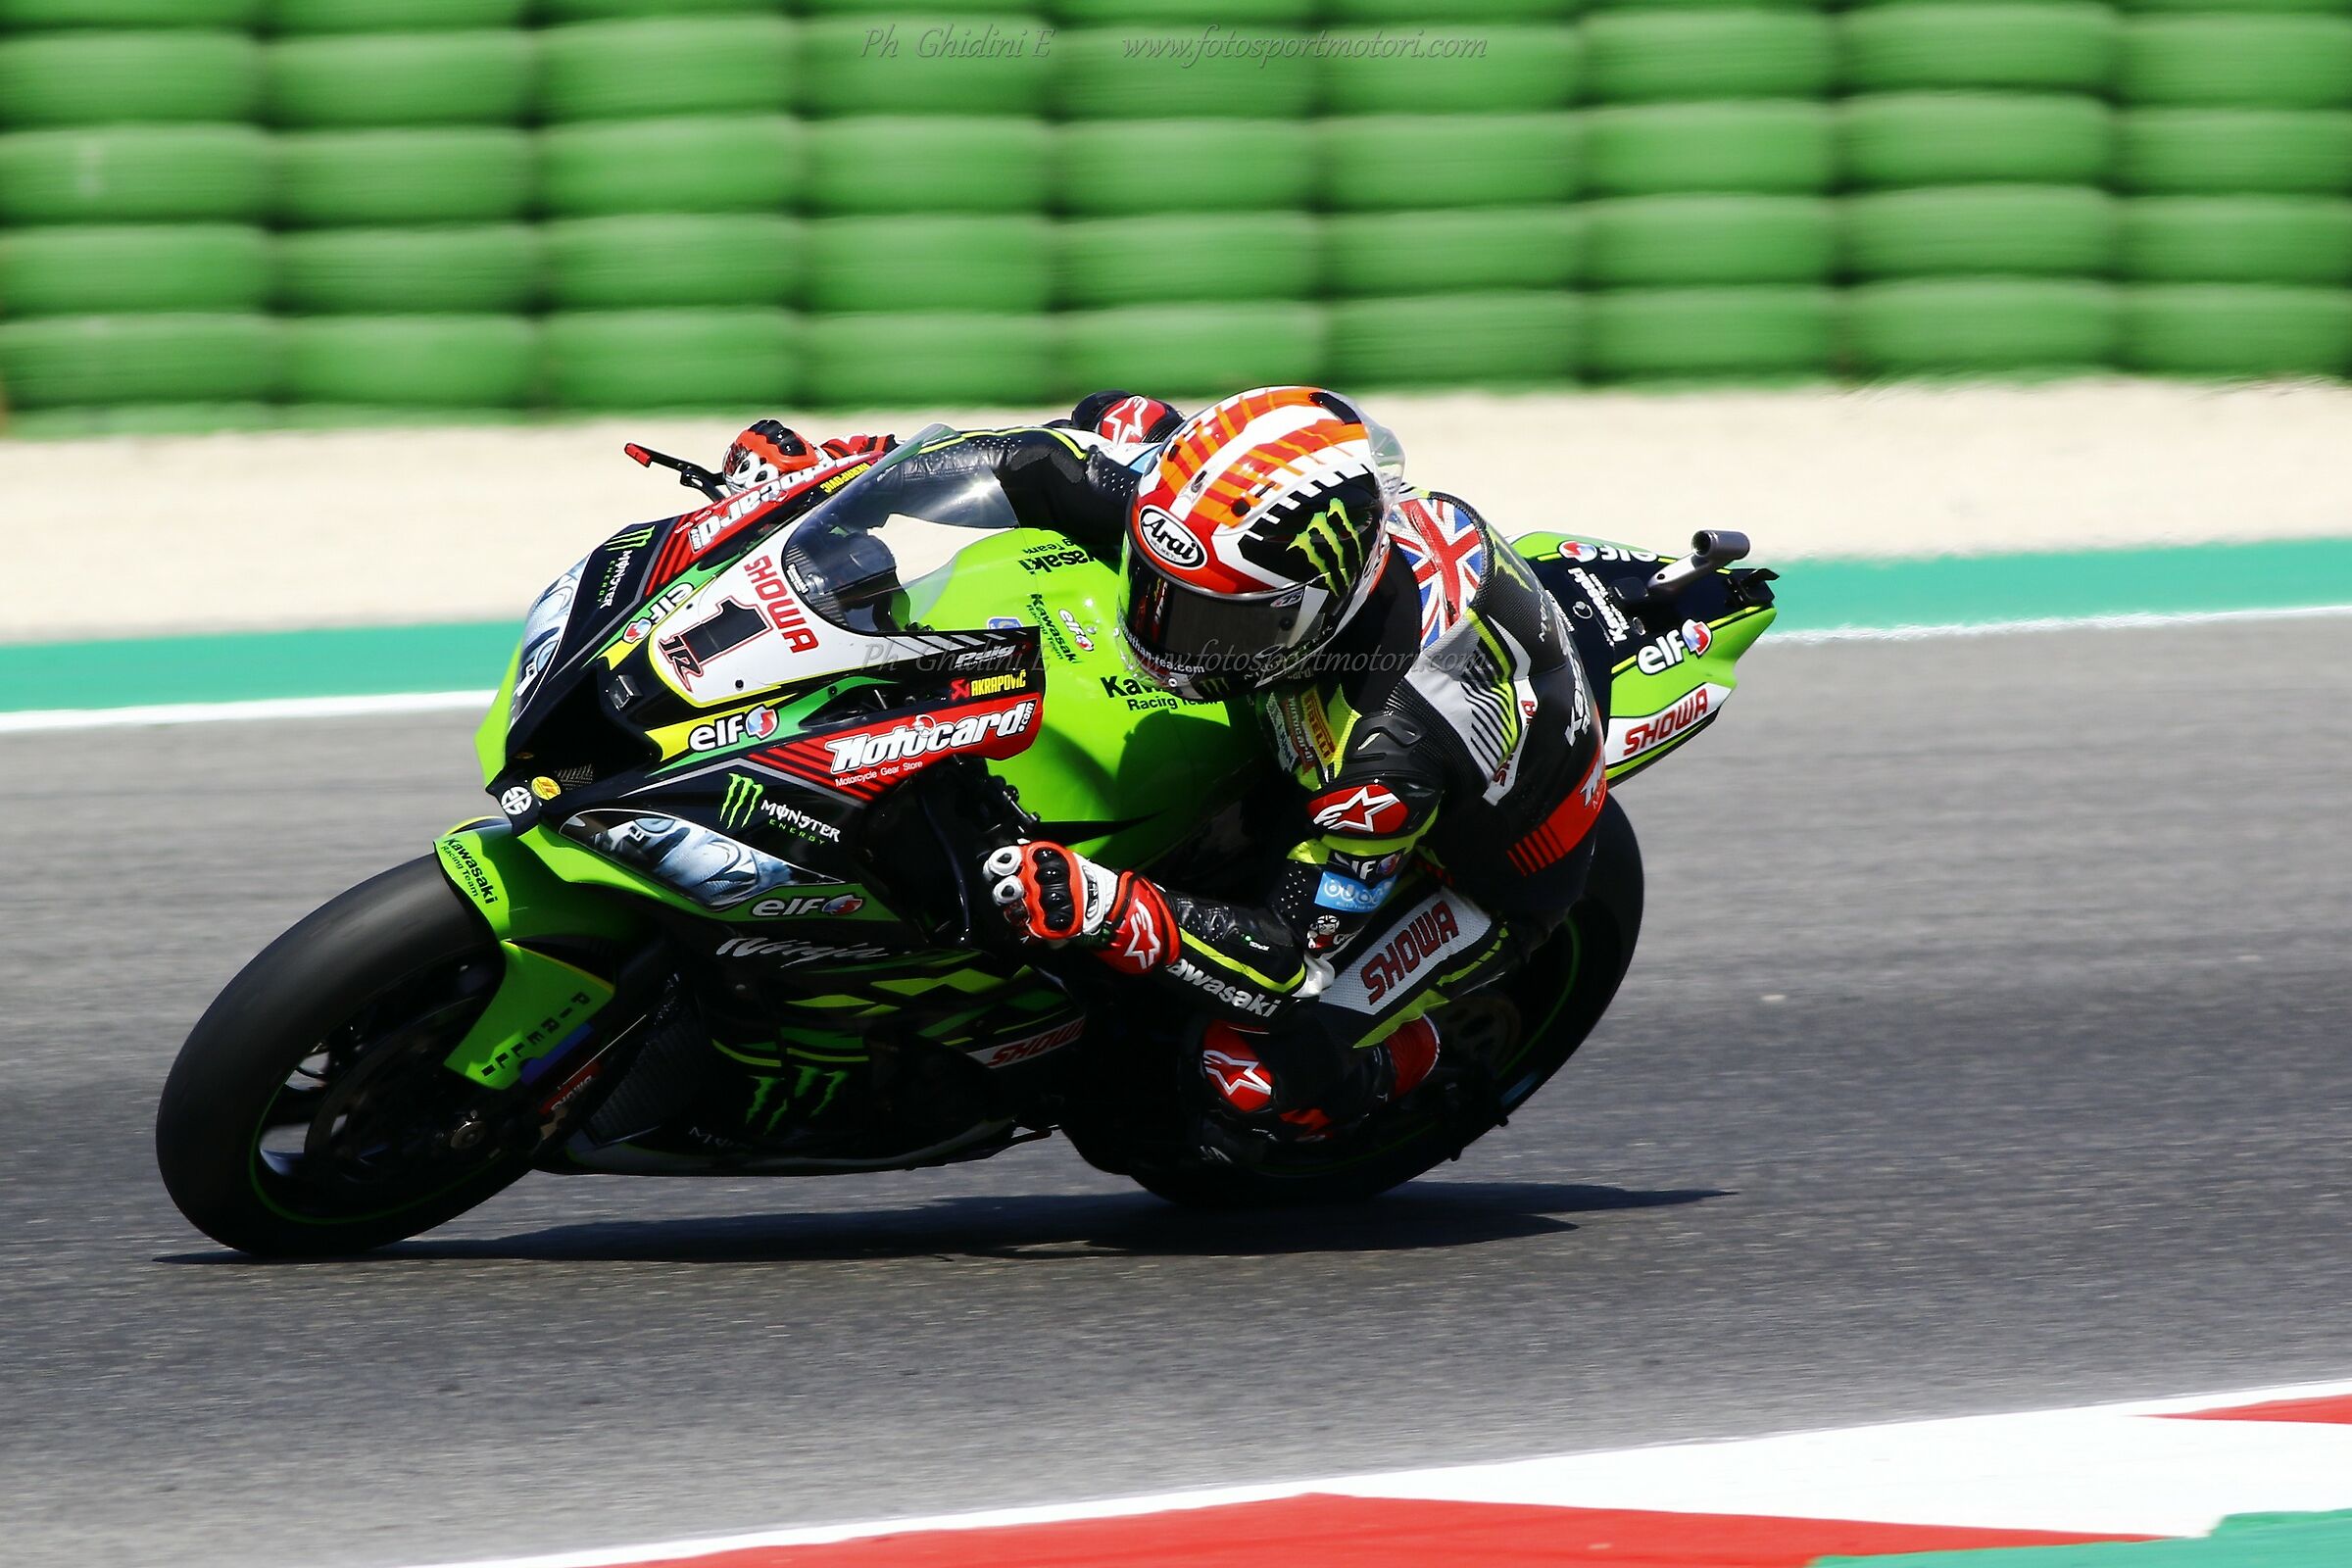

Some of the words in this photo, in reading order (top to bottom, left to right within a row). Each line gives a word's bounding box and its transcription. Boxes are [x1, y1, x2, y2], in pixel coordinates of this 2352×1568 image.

[1142, 517, 1198, 560] Arai
[648, 582, 695, 624] elf
[744, 555, 819, 654] SHOWA
[1058, 609, 1085, 637] elf
[677, 596, 773, 666] 1
[1638, 629, 1685, 675] elf
[689, 716, 745, 753] elf
[825, 699, 1037, 774] Motocard.com
[1623, 688, 1708, 757] SHOWA
[835, 768, 878, 788] Motorcycle
[880, 764, 902, 776] Gear
[903, 760, 923, 771] Store
[760, 799, 841, 843] MONSTER
[768, 818, 826, 846] ENERGY
[444, 838, 499, 904] Kawasaki
[462, 868, 479, 897] Team
[752, 898, 826, 916] elf
[716, 937, 890, 968] Ninja
[1360, 901, 1459, 1005] SHOWA
[1166, 957, 1282, 1017] awasaki
[481, 992, 590, 1077] PIRELLI
